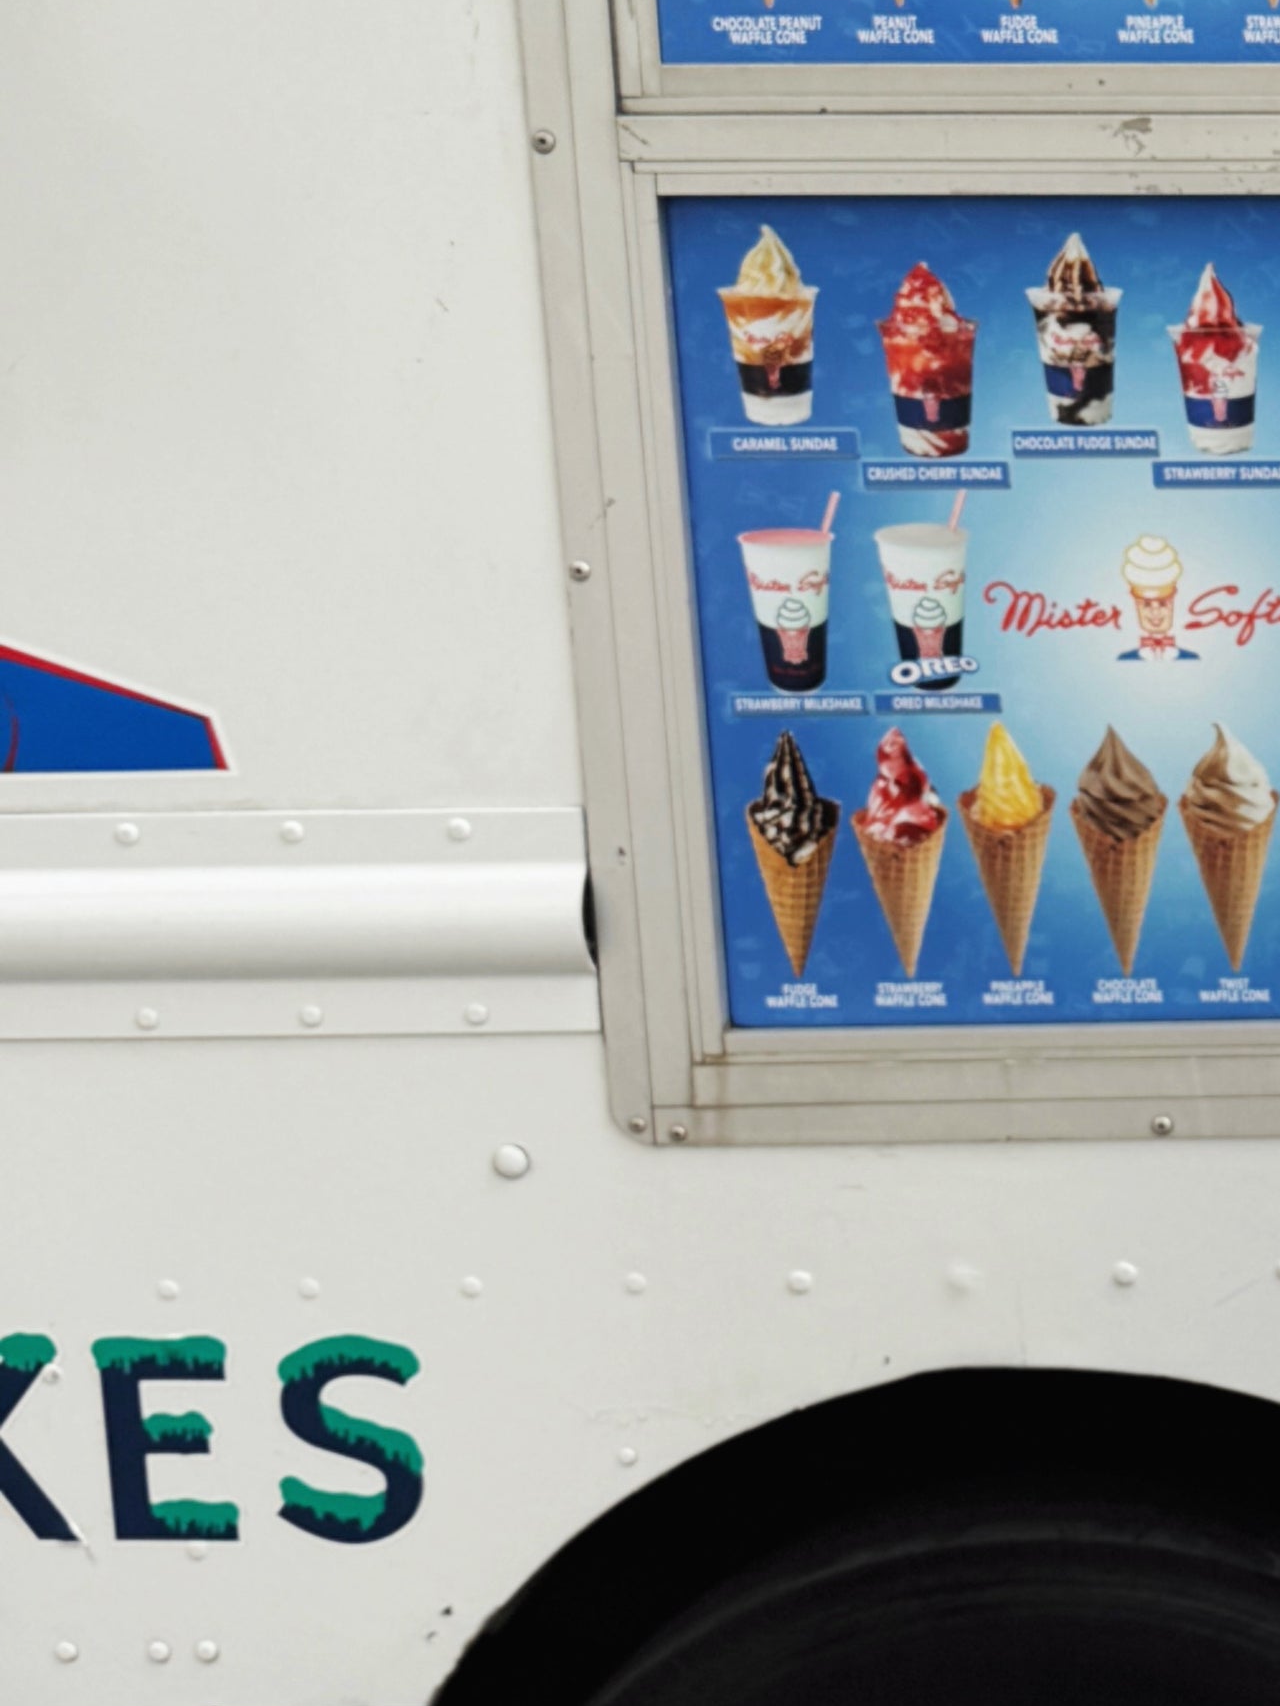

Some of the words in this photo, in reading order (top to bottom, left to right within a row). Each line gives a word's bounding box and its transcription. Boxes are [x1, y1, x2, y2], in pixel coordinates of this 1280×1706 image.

[712, 16, 777, 31] CHOCOLATE
[779, 16, 822, 31] PEANUT
[873, 16, 917, 30] PEANUT
[1000, 16, 1038, 30] FUDGE
[1126, 15, 1185, 30] PINEAPPLE
[730, 30, 773, 44] WAFFLE
[775, 30, 807, 44] CONE
[857, 30, 901, 44] WAFFLE
[903, 30, 934, 44] CONE
[981, 30, 1025, 44] WAFFLE
[1027, 30, 1059, 44] CONE
[1117, 29, 1161, 44] WAFFLE
[1163, 29, 1194, 44] CONE
[732, 437, 787, 451] CARAMEL
[790, 437, 838, 451] SUNDAE
[1014, 436, 1075, 450] CHOCOLATE
[1078, 436, 1111, 449] FUDGE
[1114, 436, 1157, 449] SUNDAE
[868, 467, 917, 480] CRUSHED
[919, 467, 958, 480] CHERRY
[961, 467, 1003, 480] SUNDAE
[1163, 467, 1237, 481] STRAWBERRY
[982, 580, 1122, 637] Mister
[890, 656, 979, 685] OREO
[735, 697, 800, 710] STRAWBERRY
[803, 697, 863, 710] MILKSHAKE
[893, 696, 922, 709] OREO
[924, 696, 983, 709] MILKSHAKE
[782, 983, 817, 995] FUDGE
[876, 982, 943, 993] STRAWBERRY
[990, 980, 1044, 992] PINEAPPLE
[1097, 978, 1158, 991] CHOCOLATE
[1219, 977, 1250, 990] TWIST
[766, 994, 807, 1008] WAFFLE
[809, 994, 838, 1008] CONE
[875, 993, 916, 1006] WAFFLE
[918, 993, 946, 1006] CONE
[983, 991, 1024, 1005] WAFFLE
[1026, 991, 1054, 1005] CONE
[1093, 990, 1134, 1004] WAFFLE
[1135, 990, 1164, 1004] CONE
[1199, 989, 1240, 1003] WAFFLE
[1242, 989, 1270, 1003] CONE
